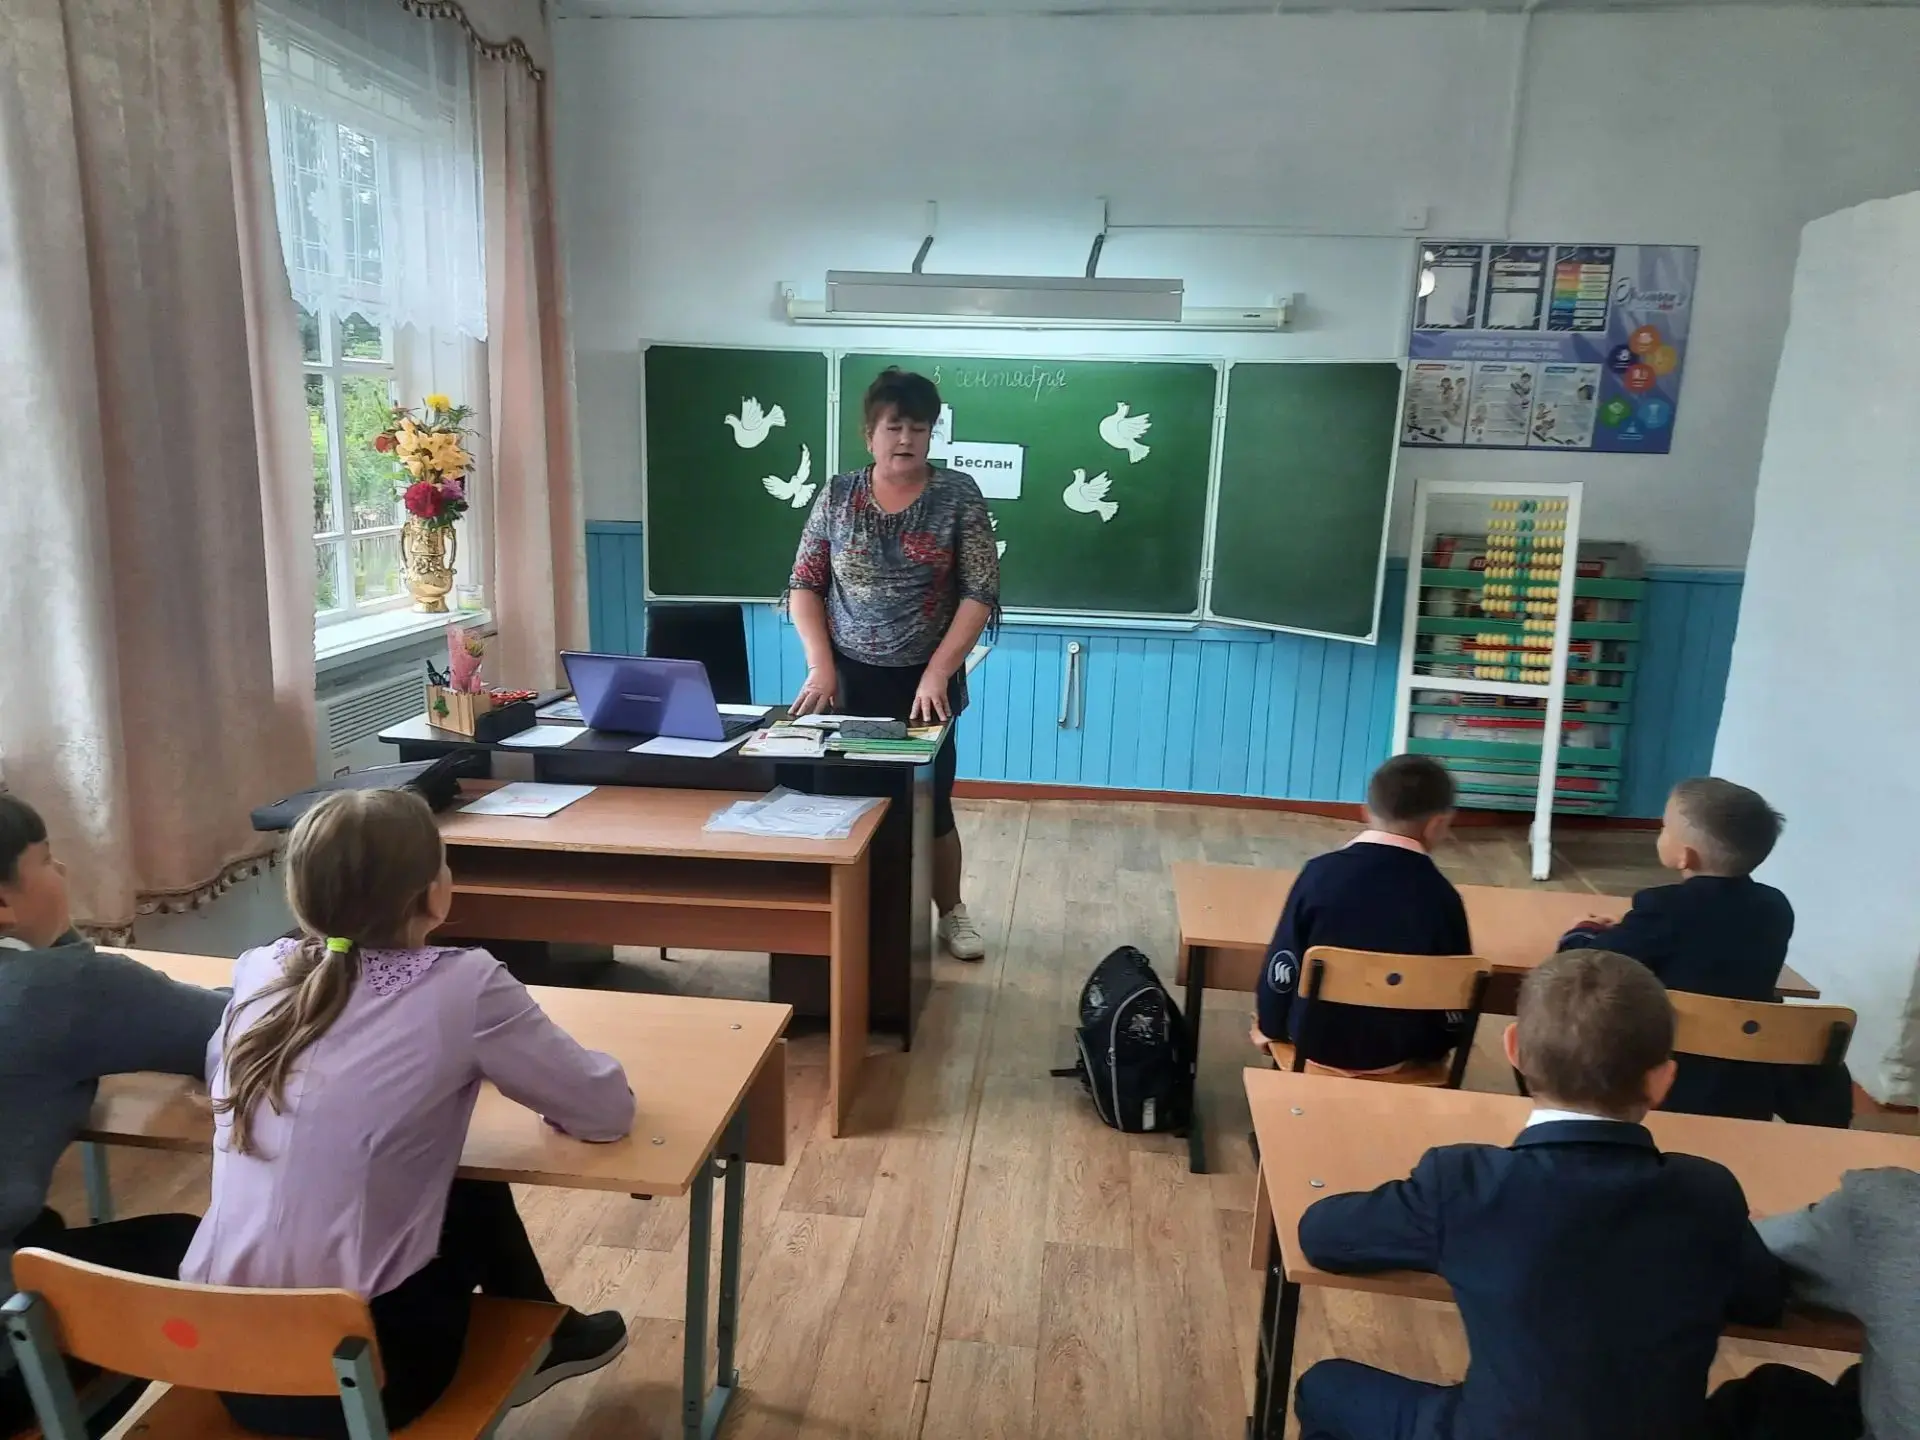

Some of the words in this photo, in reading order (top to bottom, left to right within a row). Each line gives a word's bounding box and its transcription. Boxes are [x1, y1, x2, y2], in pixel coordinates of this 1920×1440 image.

[932, 364, 942, 386] 3
[955, 364, 1068, 402] сентября
[953, 455, 1013, 469] Беслан
